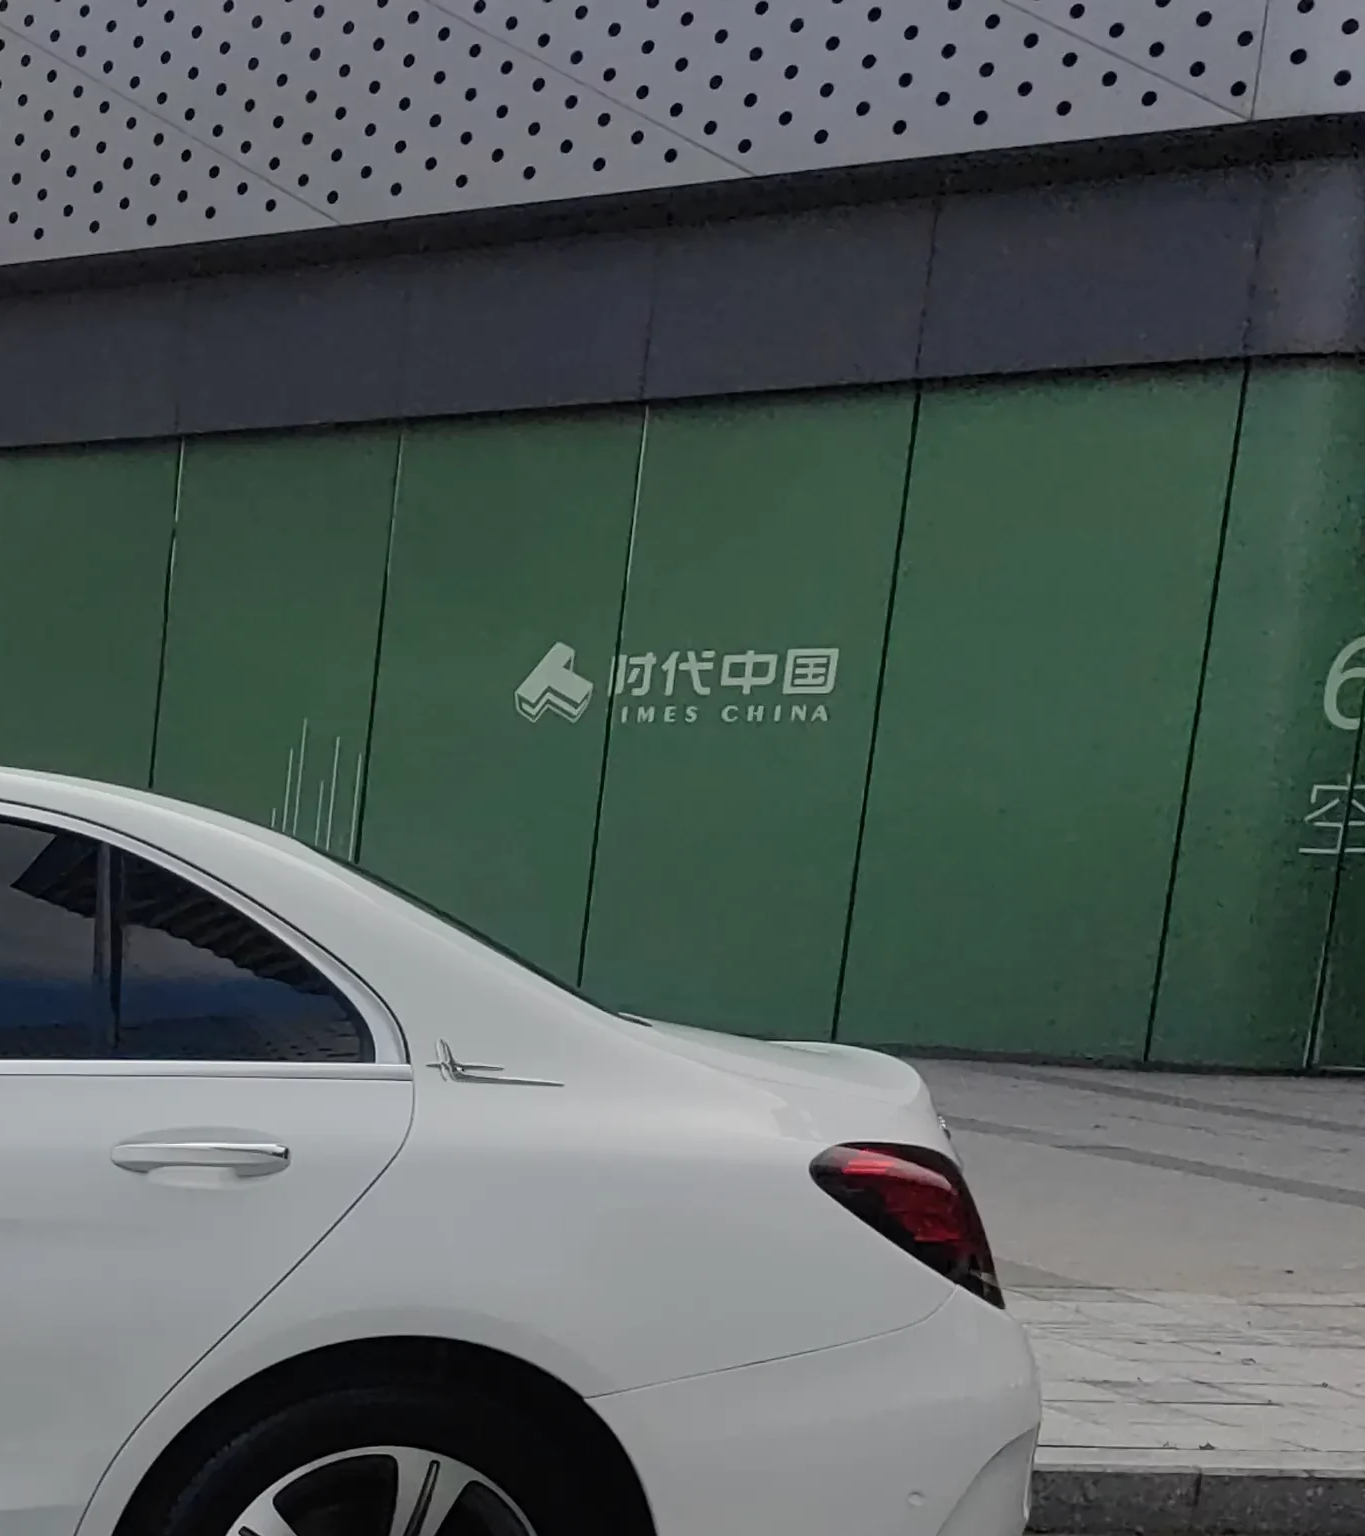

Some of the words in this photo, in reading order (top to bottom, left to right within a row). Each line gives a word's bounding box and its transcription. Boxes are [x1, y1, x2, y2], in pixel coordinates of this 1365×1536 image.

[608, 648, 839, 697] 时代中国
[620, 704, 698, 724] IMES
[721, 703, 829, 723] CHINA
